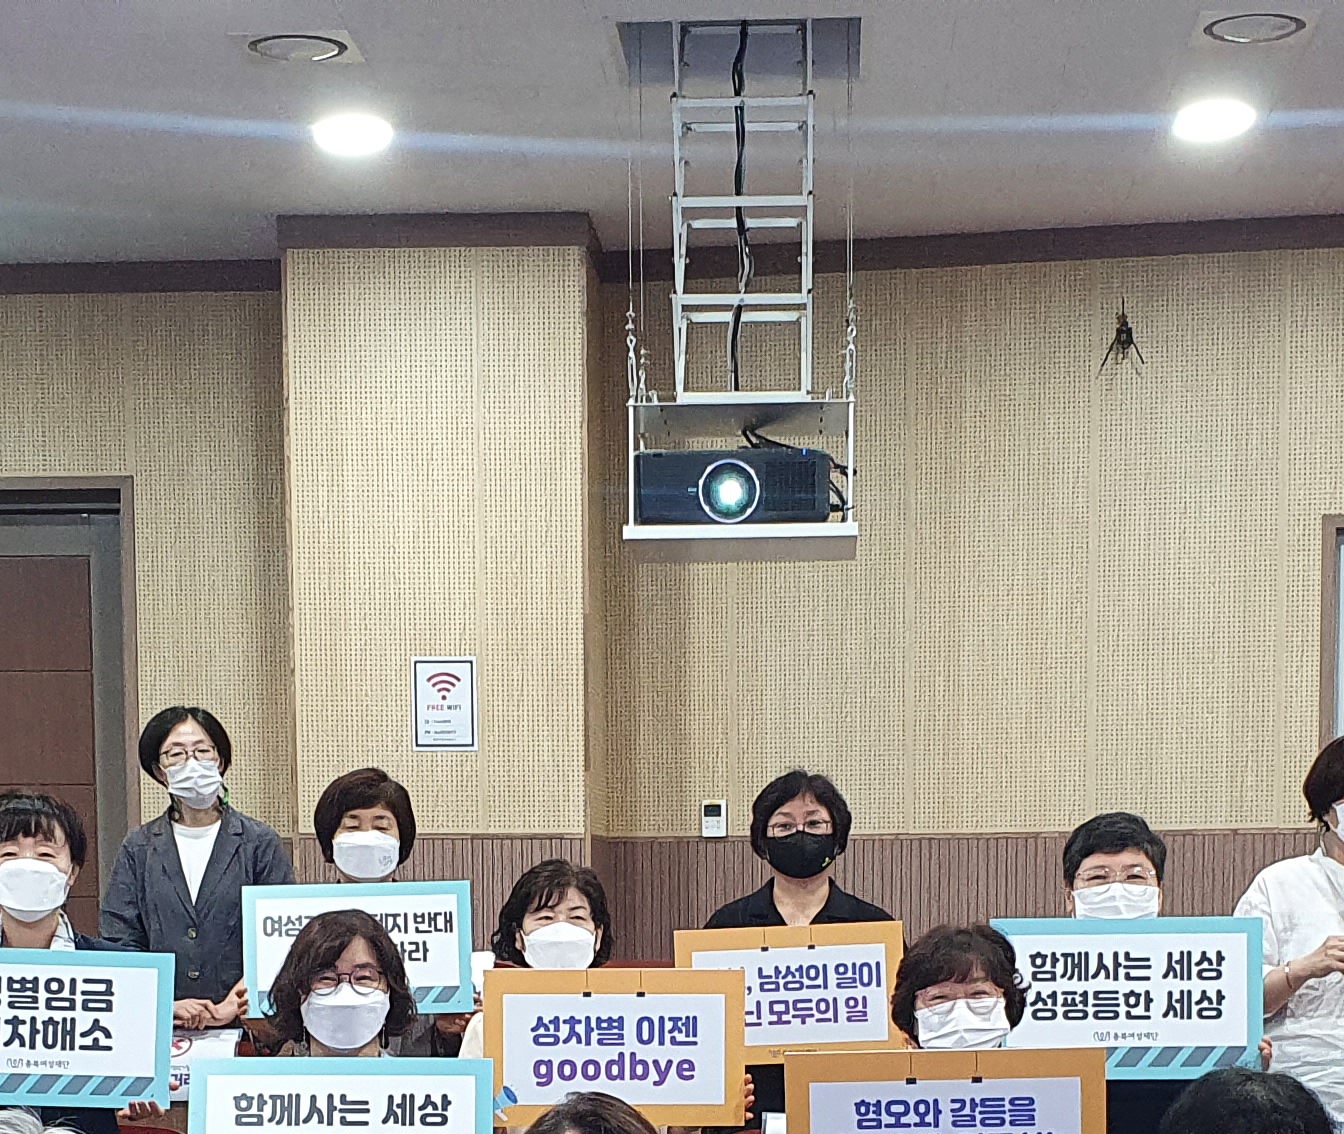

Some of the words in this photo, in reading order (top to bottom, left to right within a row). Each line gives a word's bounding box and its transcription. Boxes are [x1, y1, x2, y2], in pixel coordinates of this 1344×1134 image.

[413, 911, 454, 933] 반대
[758, 963, 828, 993] 남성의
[834, 961, 882, 989] 일이
[1029, 951, 1152, 982] 함께사는
[1162, 950, 1225, 981] 세상
[768, 997, 838, 1025] 모두의
[845, 995, 868, 1022] 일
[1029, 989, 1153, 1021] 성평등한
[1162, 989, 1225, 1020] 세상
[530, 1015, 625, 1047] 성차별
[633, 1015, 698, 1047] 이젠
[532, 1052, 696, 1086] goodbye
[233, 1092, 371, 1129] 함께사는
[381, 1092, 452, 1129] 세상
[854, 1099, 943, 1132] 혐오와
[951, 1096, 1037, 1129] 갈등을
